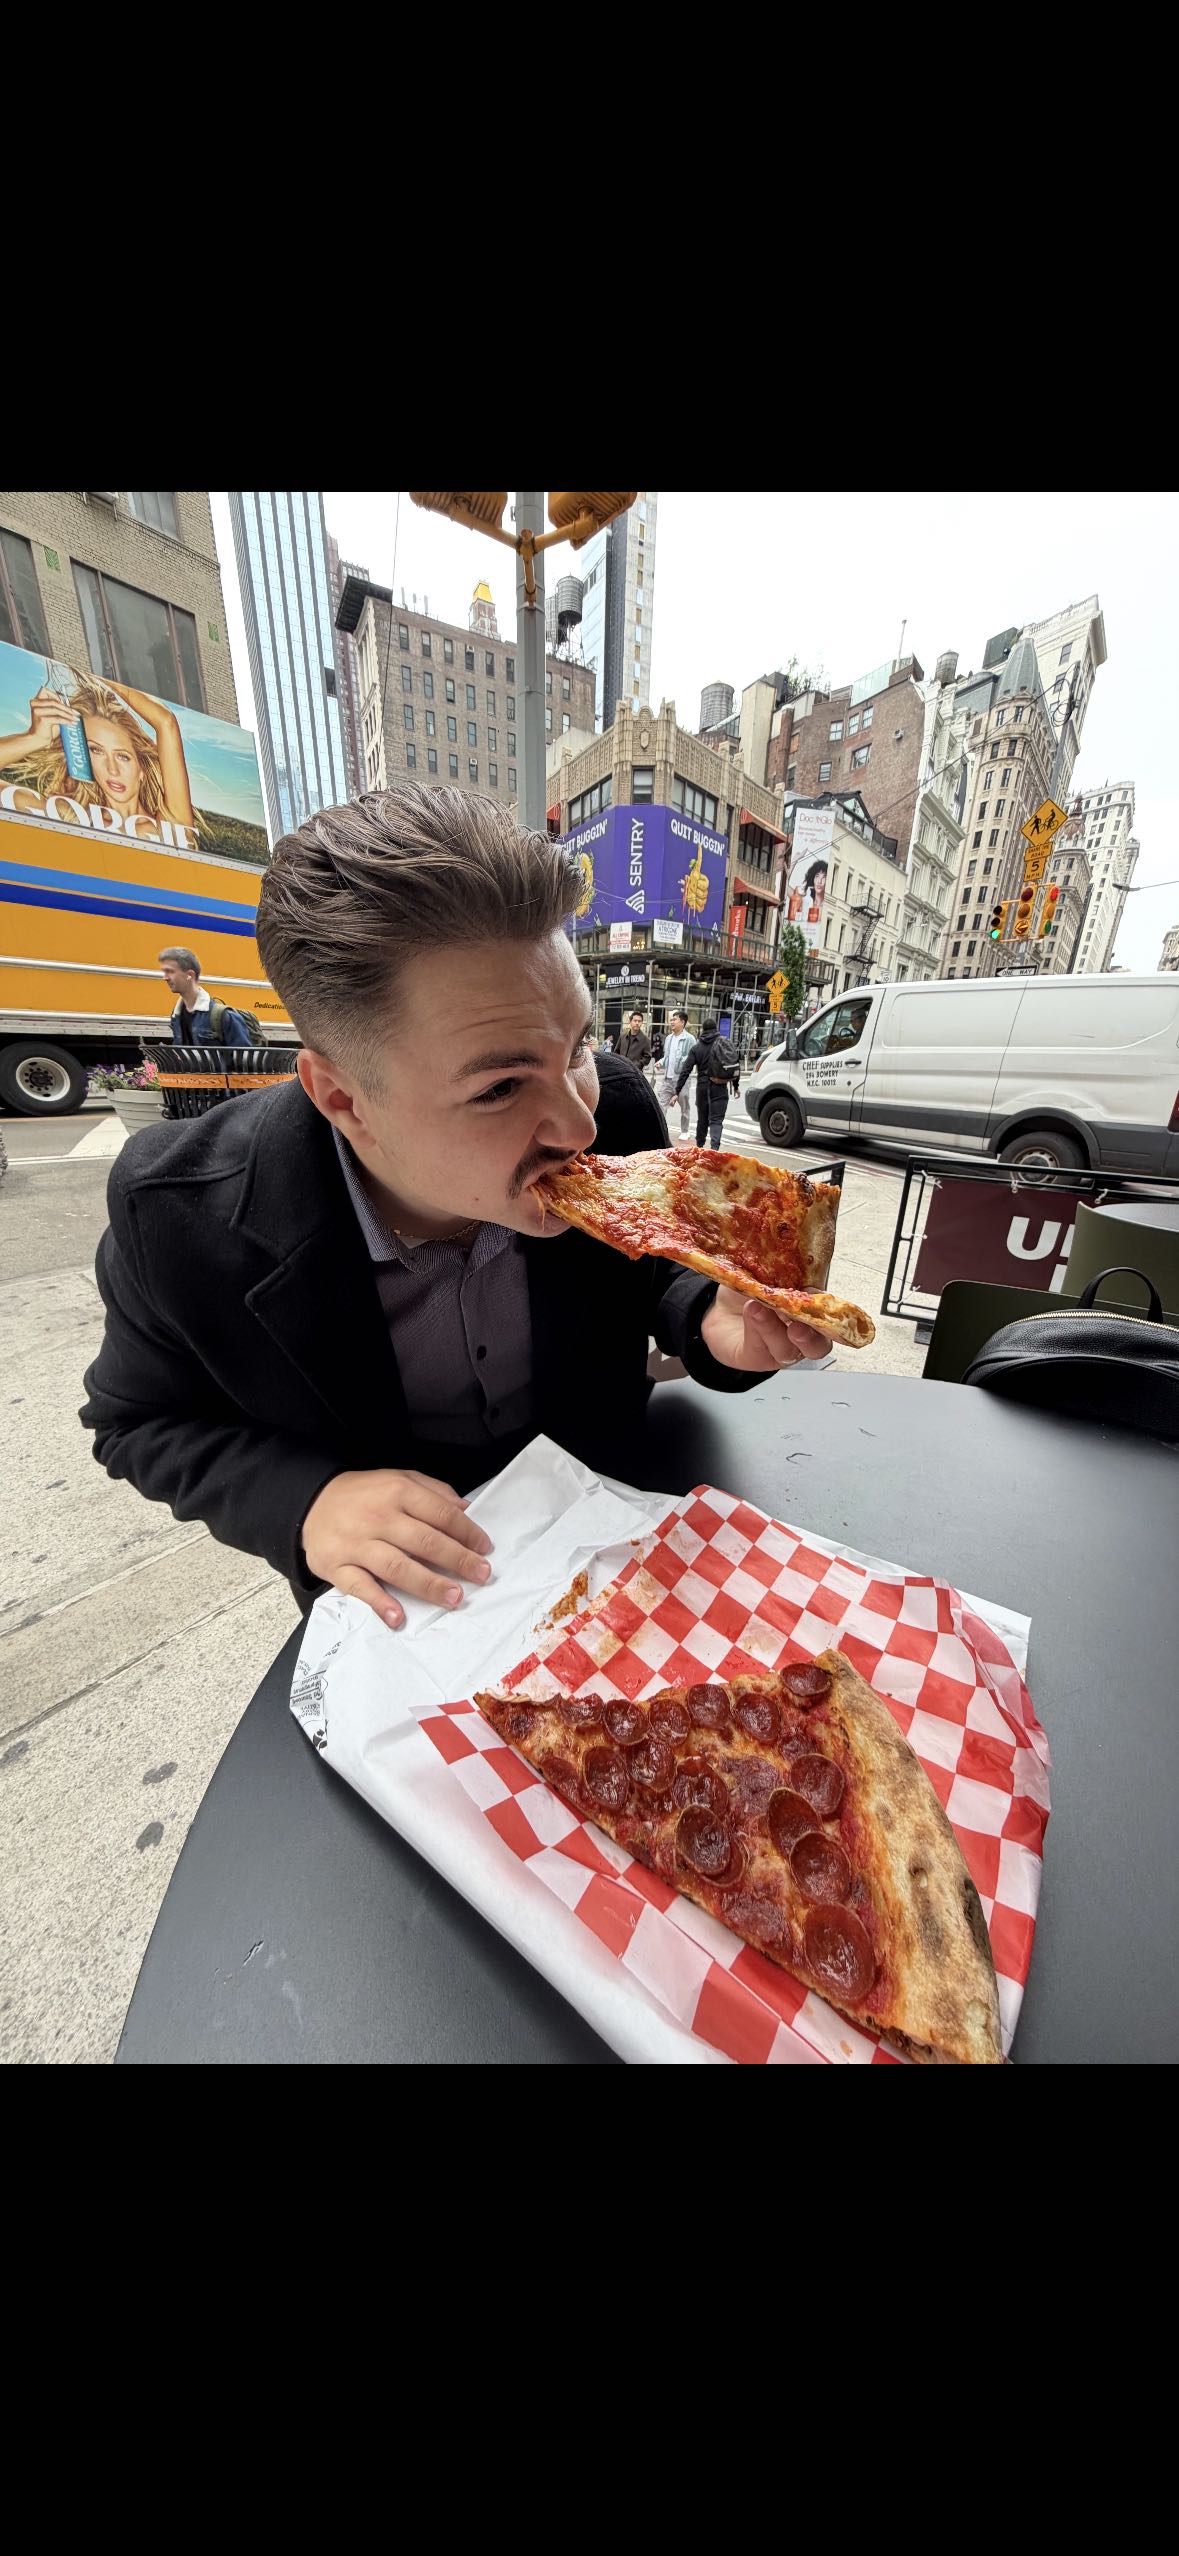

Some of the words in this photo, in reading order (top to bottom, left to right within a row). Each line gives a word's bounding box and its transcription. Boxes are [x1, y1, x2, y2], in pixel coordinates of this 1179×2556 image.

[577, 818, 607, 848] BUGGIN'
[670, 818, 693, 841] QUIT
[693, 829, 725, 856] BUGGIN'
[630, 817, 645, 887] SENTRY
[1031, 860, 1040, 872] 5
[802, 1061, 819, 1070] CHEF
[820, 1060, 843, 1069] SUPPLIES
[816, 1070, 839, 1078] BOWERY
